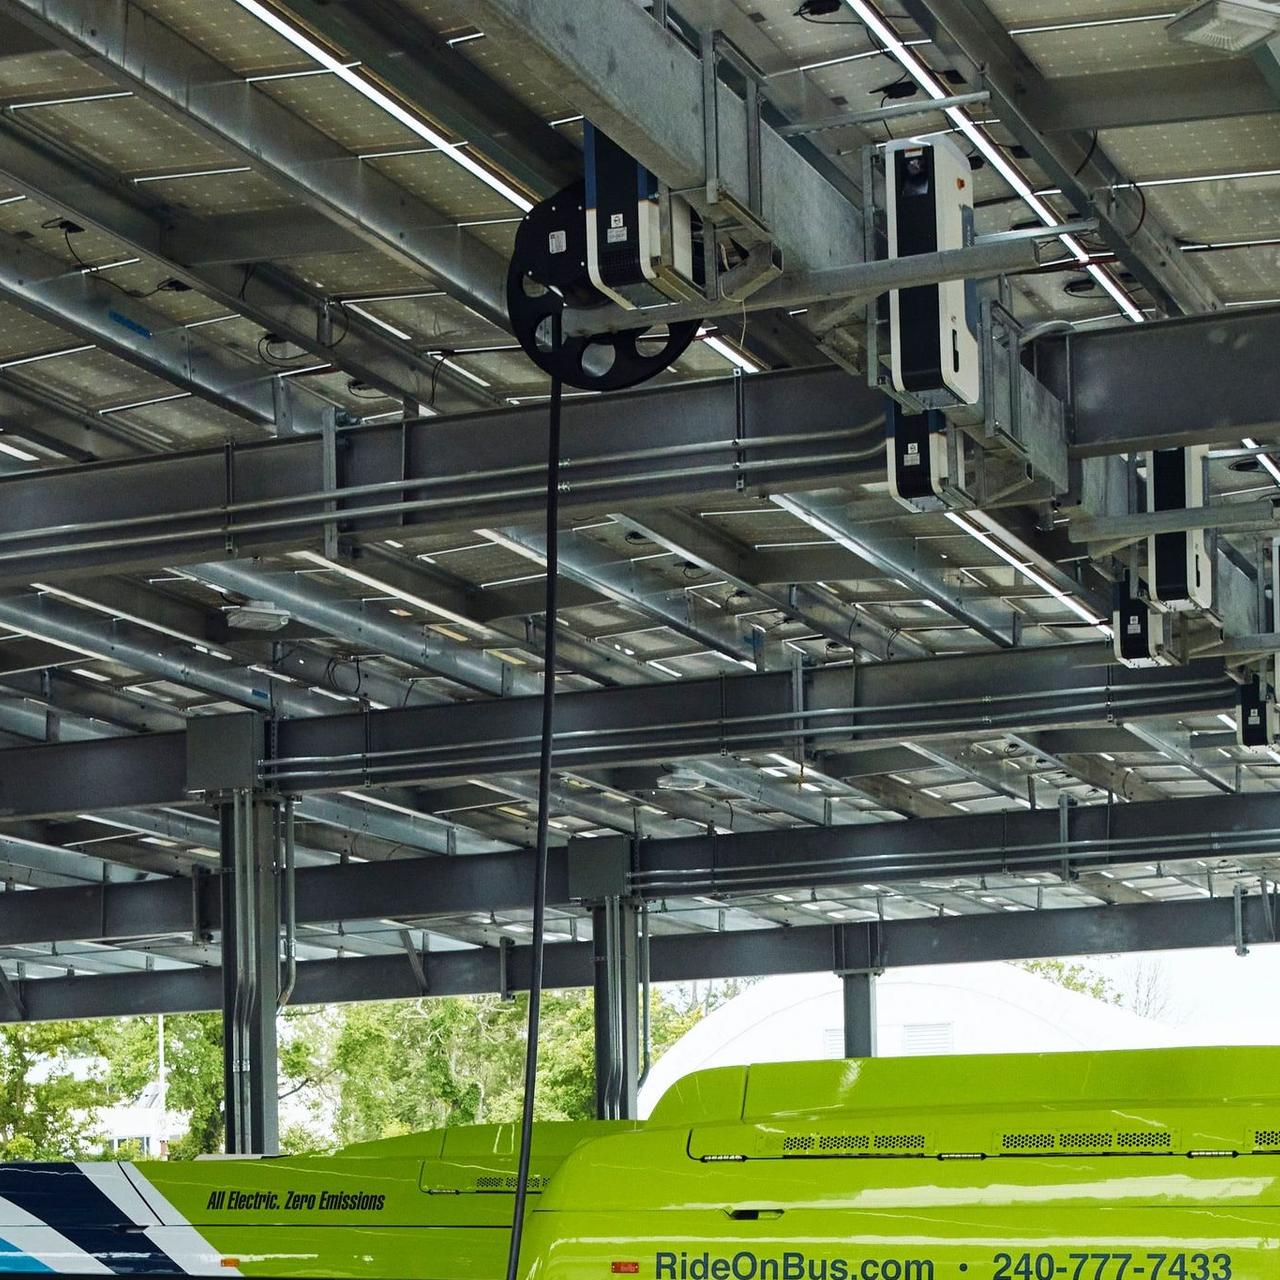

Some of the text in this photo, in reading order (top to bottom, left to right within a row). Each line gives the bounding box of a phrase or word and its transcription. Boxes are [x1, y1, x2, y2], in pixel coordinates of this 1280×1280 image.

[207, 1191, 385, 1211] All Electric. Zero Emissions
